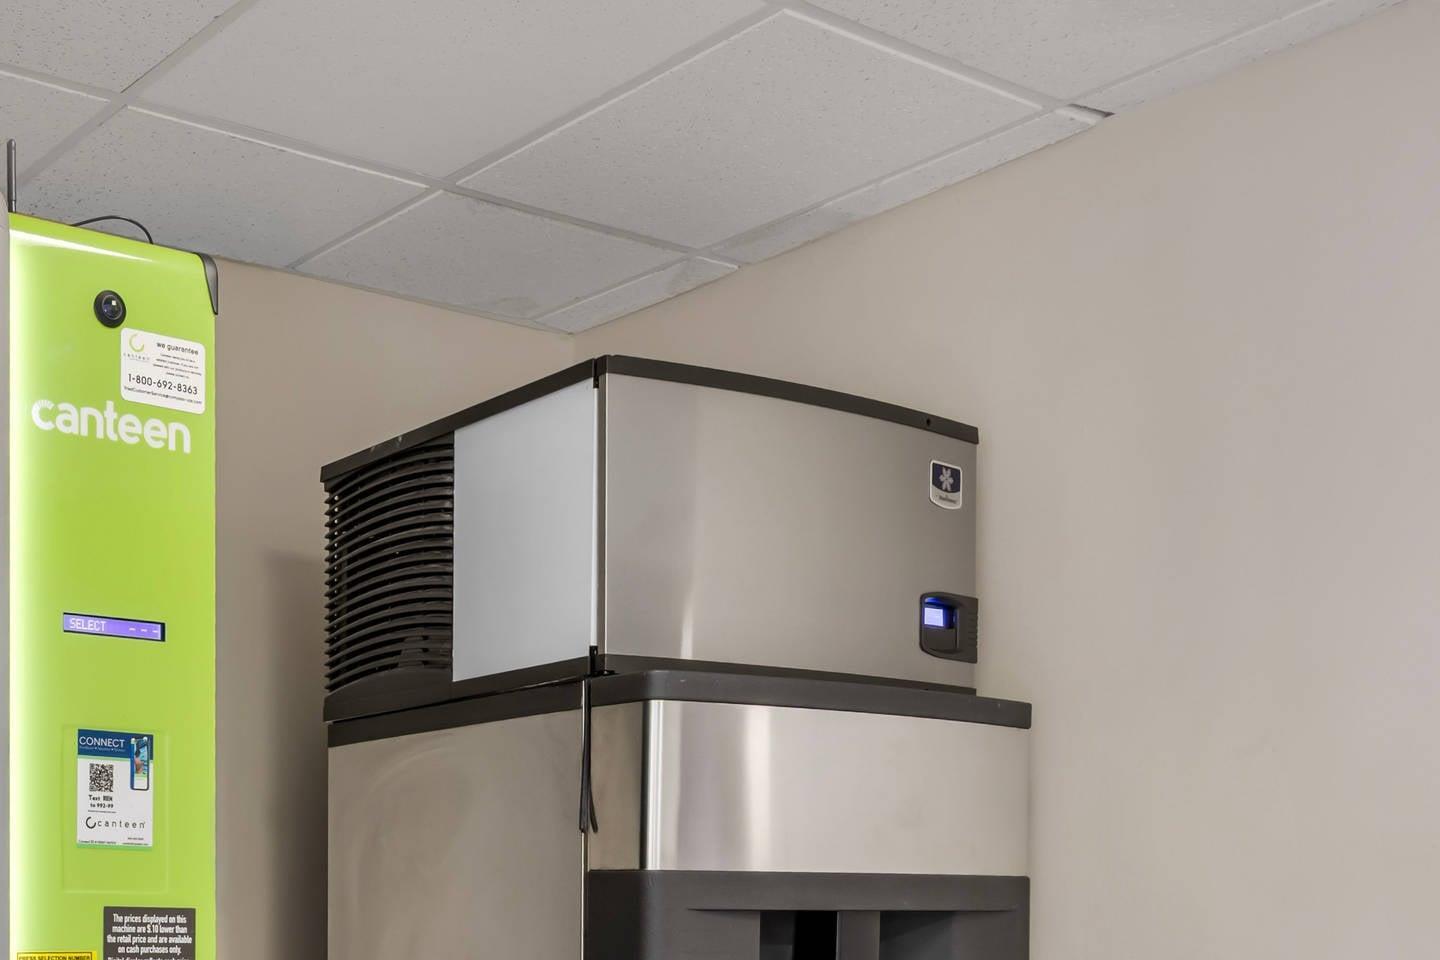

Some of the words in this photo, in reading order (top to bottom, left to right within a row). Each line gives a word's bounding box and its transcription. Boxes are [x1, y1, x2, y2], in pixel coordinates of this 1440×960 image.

[156, 342, 166, 350] we
[167, 344, 199, 356] guarantee
[127, 373, 198, 396] 1-800-692-8363
[31, 399, 192, 455] canteen
[69, 617, 106, 632] SELECT
[79, 736, 125, 748] CONNECT
[97, 820, 146, 829] canteen
[113, 914, 123, 923] The
[124, 914, 141, 926] prices
[142, 914, 168, 926] displayed
[177, 915, 187, 924] this
[112, 924, 136, 933] machine
[160, 925, 175, 934] lower
[176, 925, 188, 934] than
[107, 934, 116, 943] the
[117, 935, 132, 943] retail
[132, 935, 147, 945] price
[147, 935, 158, 943] and
[168, 935, 193, 944] available
[126, 945, 140, 953] cash
[140, 945, 169, 956] purchases
